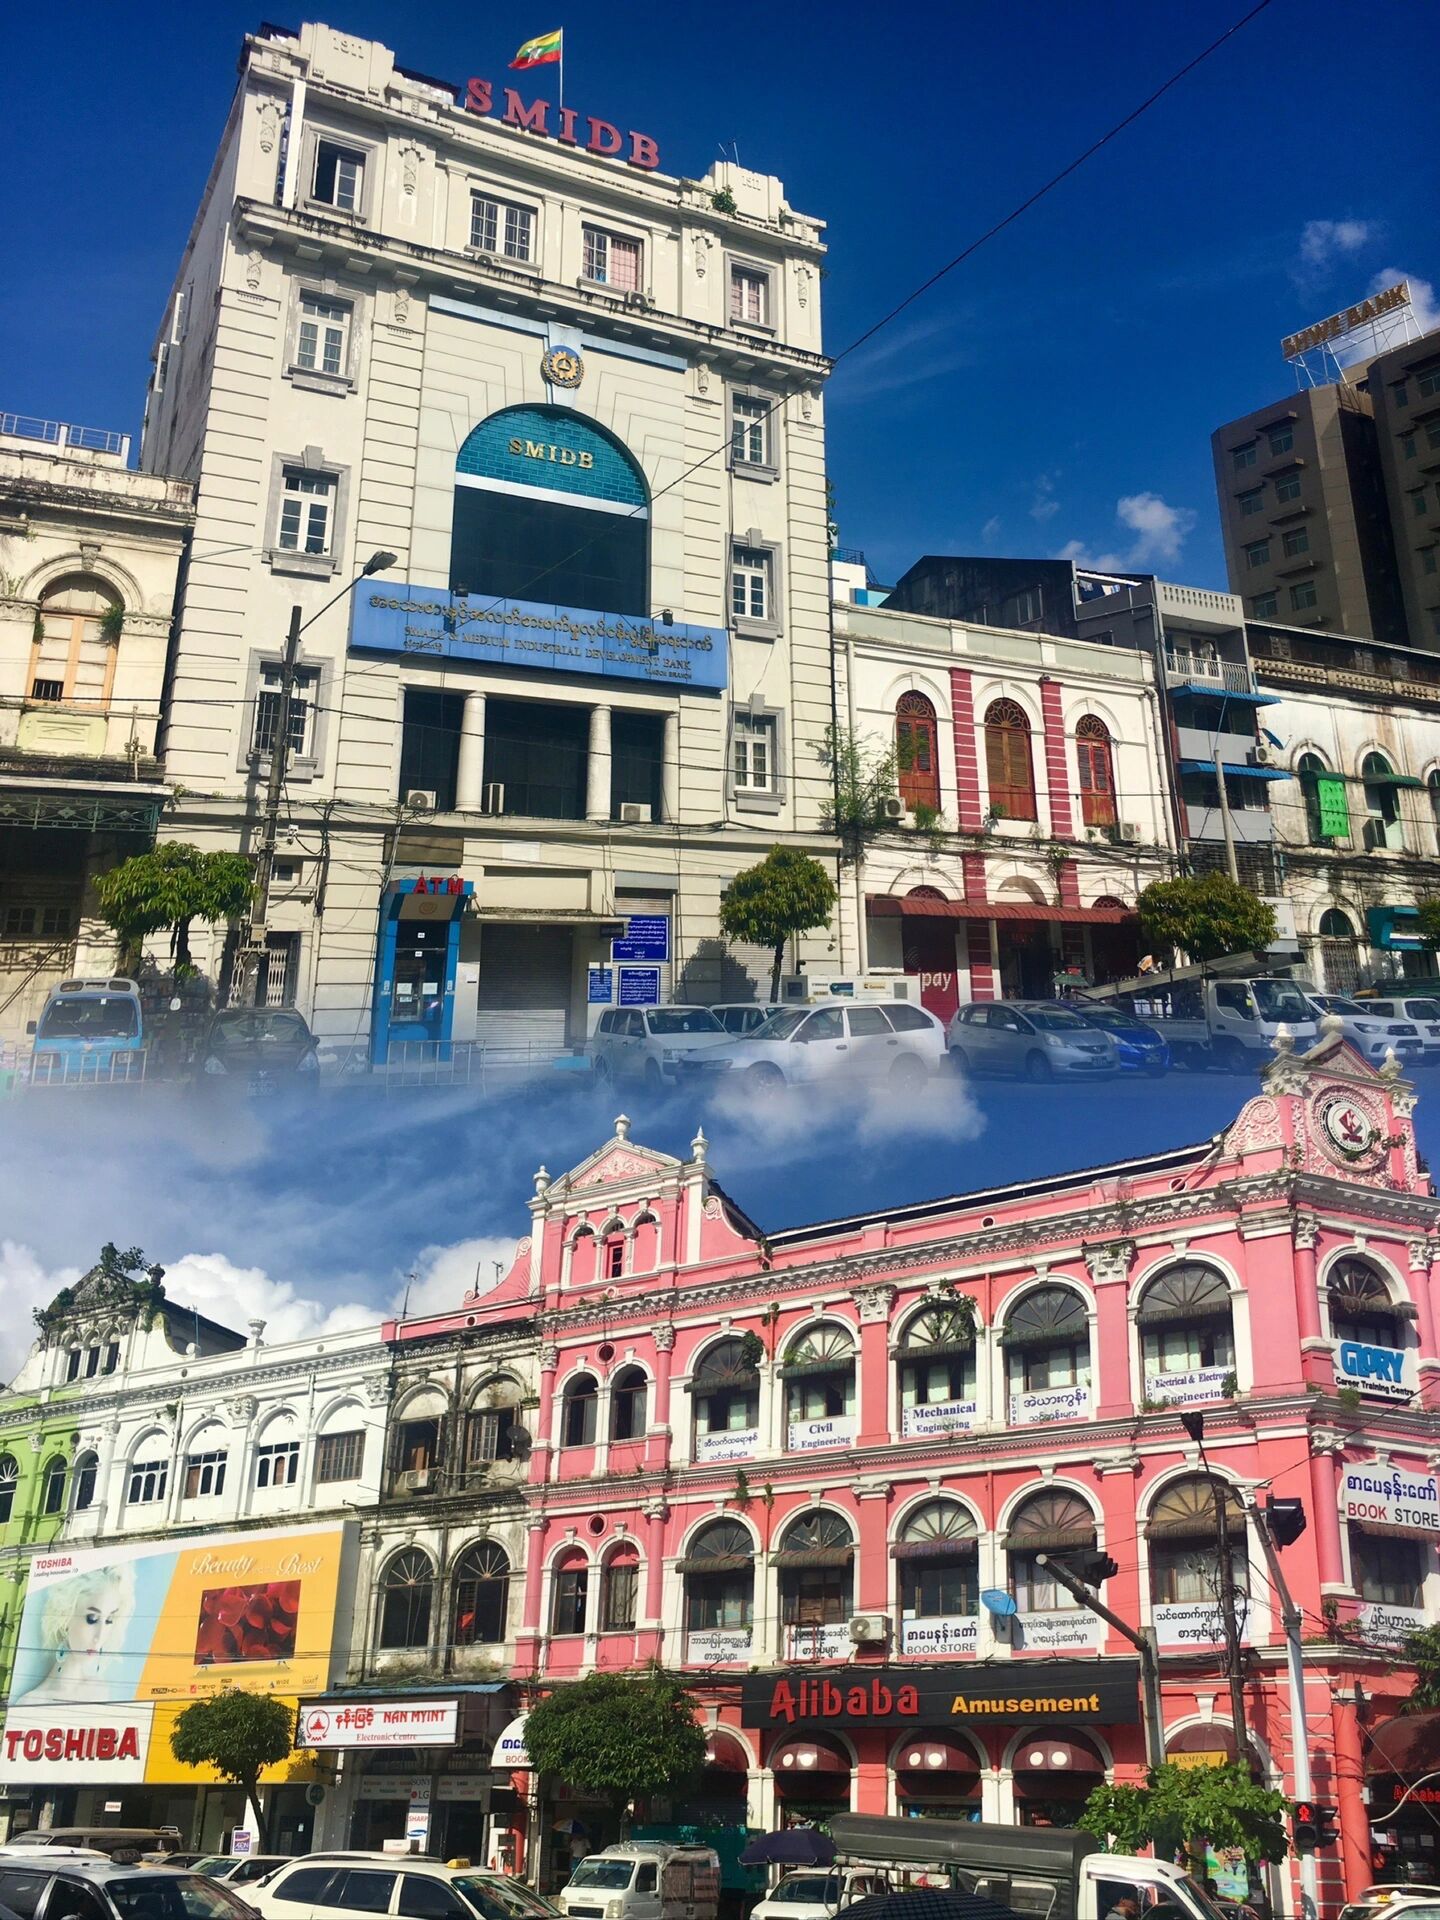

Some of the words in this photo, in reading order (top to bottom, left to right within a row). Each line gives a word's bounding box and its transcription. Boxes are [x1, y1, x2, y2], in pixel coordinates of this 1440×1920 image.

[465, 77, 660, 170] SMIDB
[1346, 284, 1408, 326] BANK
[509, 437, 593, 469] SMIDB
[462, 633, 510, 648] MEDIUM
[514, 640, 581, 657] INDUSTRIAL
[585, 648, 660, 667] DEVELOPMENT
[663, 658, 692, 671] BANK
[413, 875, 464, 895] ATM
[1340, 1342, 1404, 1384] GLORY
[1155, 1375, 1188, 1389] Electrical
[1188, 1374, 1195, 1384] &
[1198, 1370, 1234, 1382] Electroni
[1335, 1376, 1360, 1389] Career
[1361, 1380, 1389, 1395] Training
[1390, 1385, 1415, 1397] Centre
[913, 1403, 977, 1420] Mechanical
[808, 1422, 833, 1435] Civil
[916, 1420, 970, 1434] Engineering
[801, 1436, 851, 1449] Engineering
[1347, 1472, 1437, 1503] စာပေနန်းတော်
[1347, 1502, 1388, 1521] BOOK
[1394, 1507, 1440, 1528] STORE
[36, 1557, 72, 1569] TOSHIBA
[190, 1552, 254, 1579] Beauty
[276, 1552, 322, 1577] Best
[907, 1621, 977, 1644] စာပေနန်းတော်
[907, 1643, 938, 1655] BOOK
[940, 1642, 977, 1653] STORE
[769, 1678, 920, 1724] Alibaba
[951, 1693, 1100, 1715] Amusement
[335, 1707, 374, 1730] နန်းမြင့်
[383, 1710, 408, 1724] NAN
[410, 1709, 448, 1723] MYINT
[5, 1727, 140, 1761] TOSHIBA
[356, 1732, 393, 1742] Electronic
[392, 1731, 417, 1741] Centre
[505, 1755, 529, 1764] BOOK
[419, 1790, 430, 1799] LG
